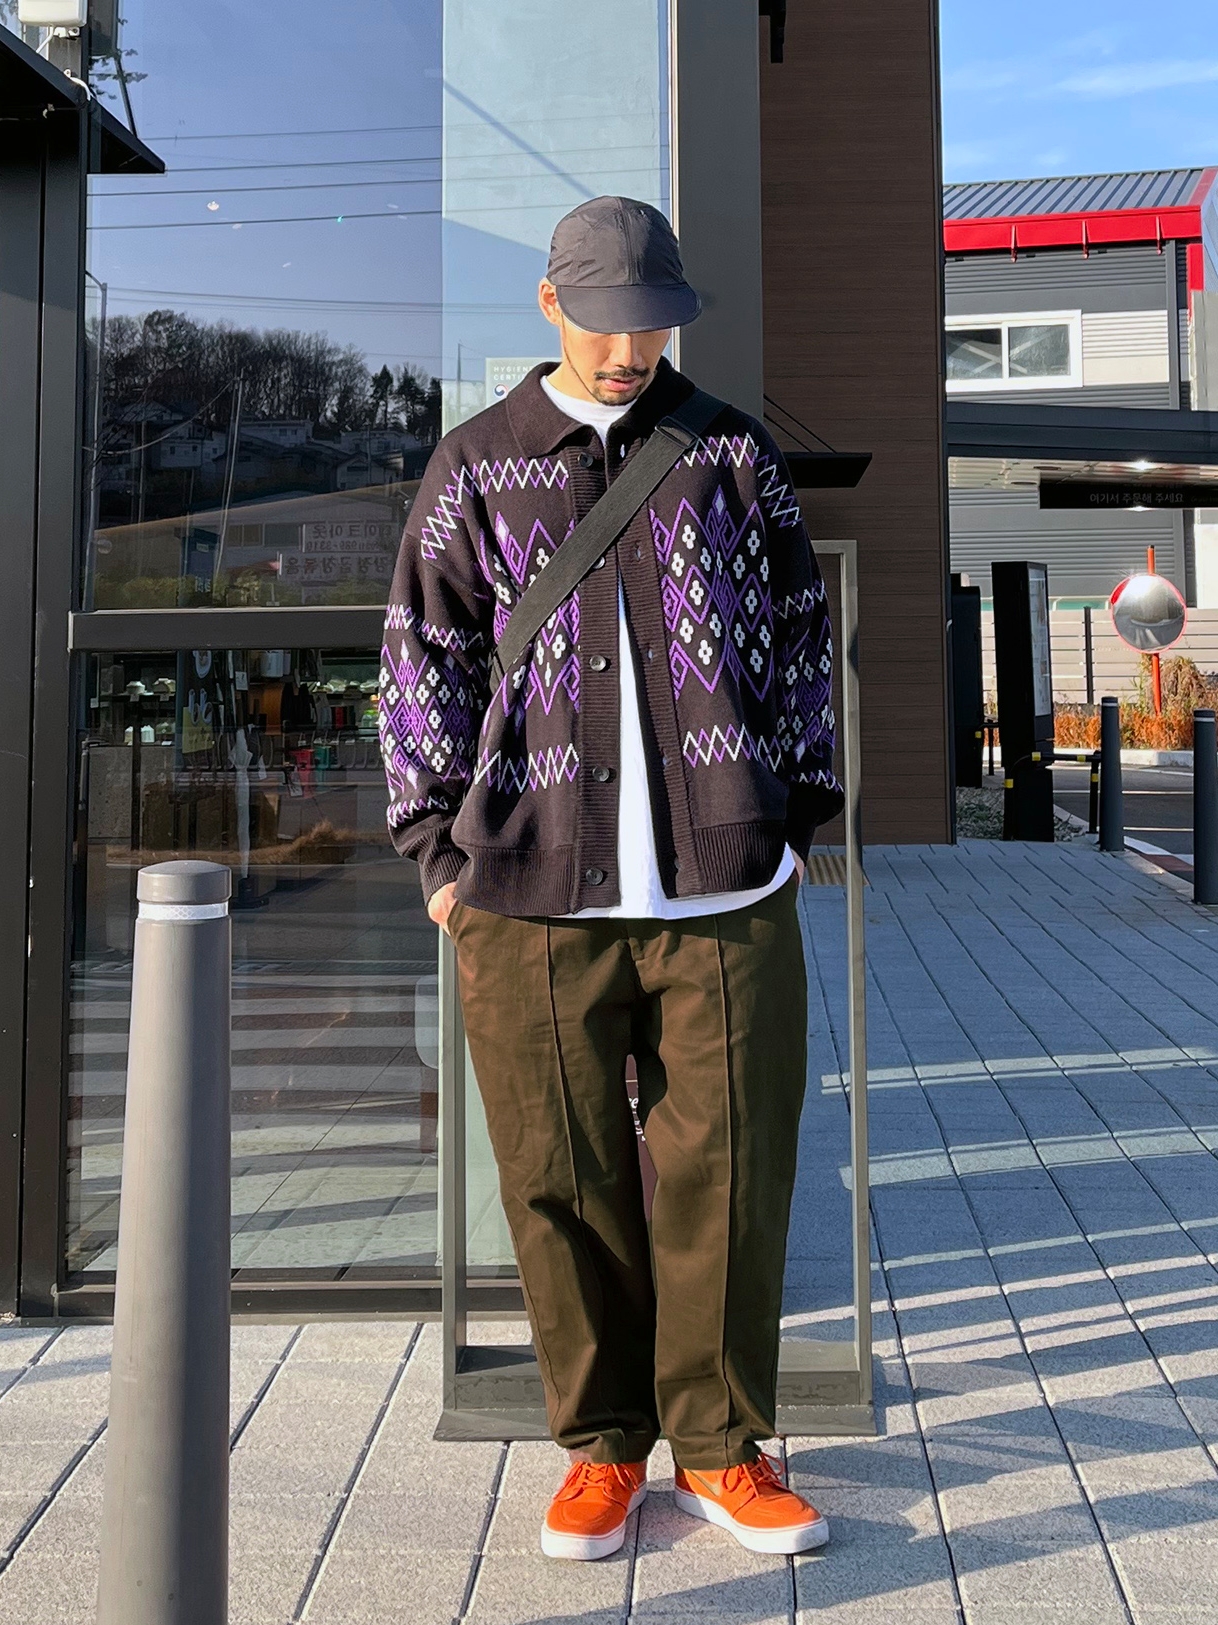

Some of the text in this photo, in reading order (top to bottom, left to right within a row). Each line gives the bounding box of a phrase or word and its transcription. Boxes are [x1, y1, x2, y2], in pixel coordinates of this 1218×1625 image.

[1089, 493, 1119, 504] 여기서
[1123, 493, 1152, 504] 주문해
[1155, 493, 1184, 504] 주세요
